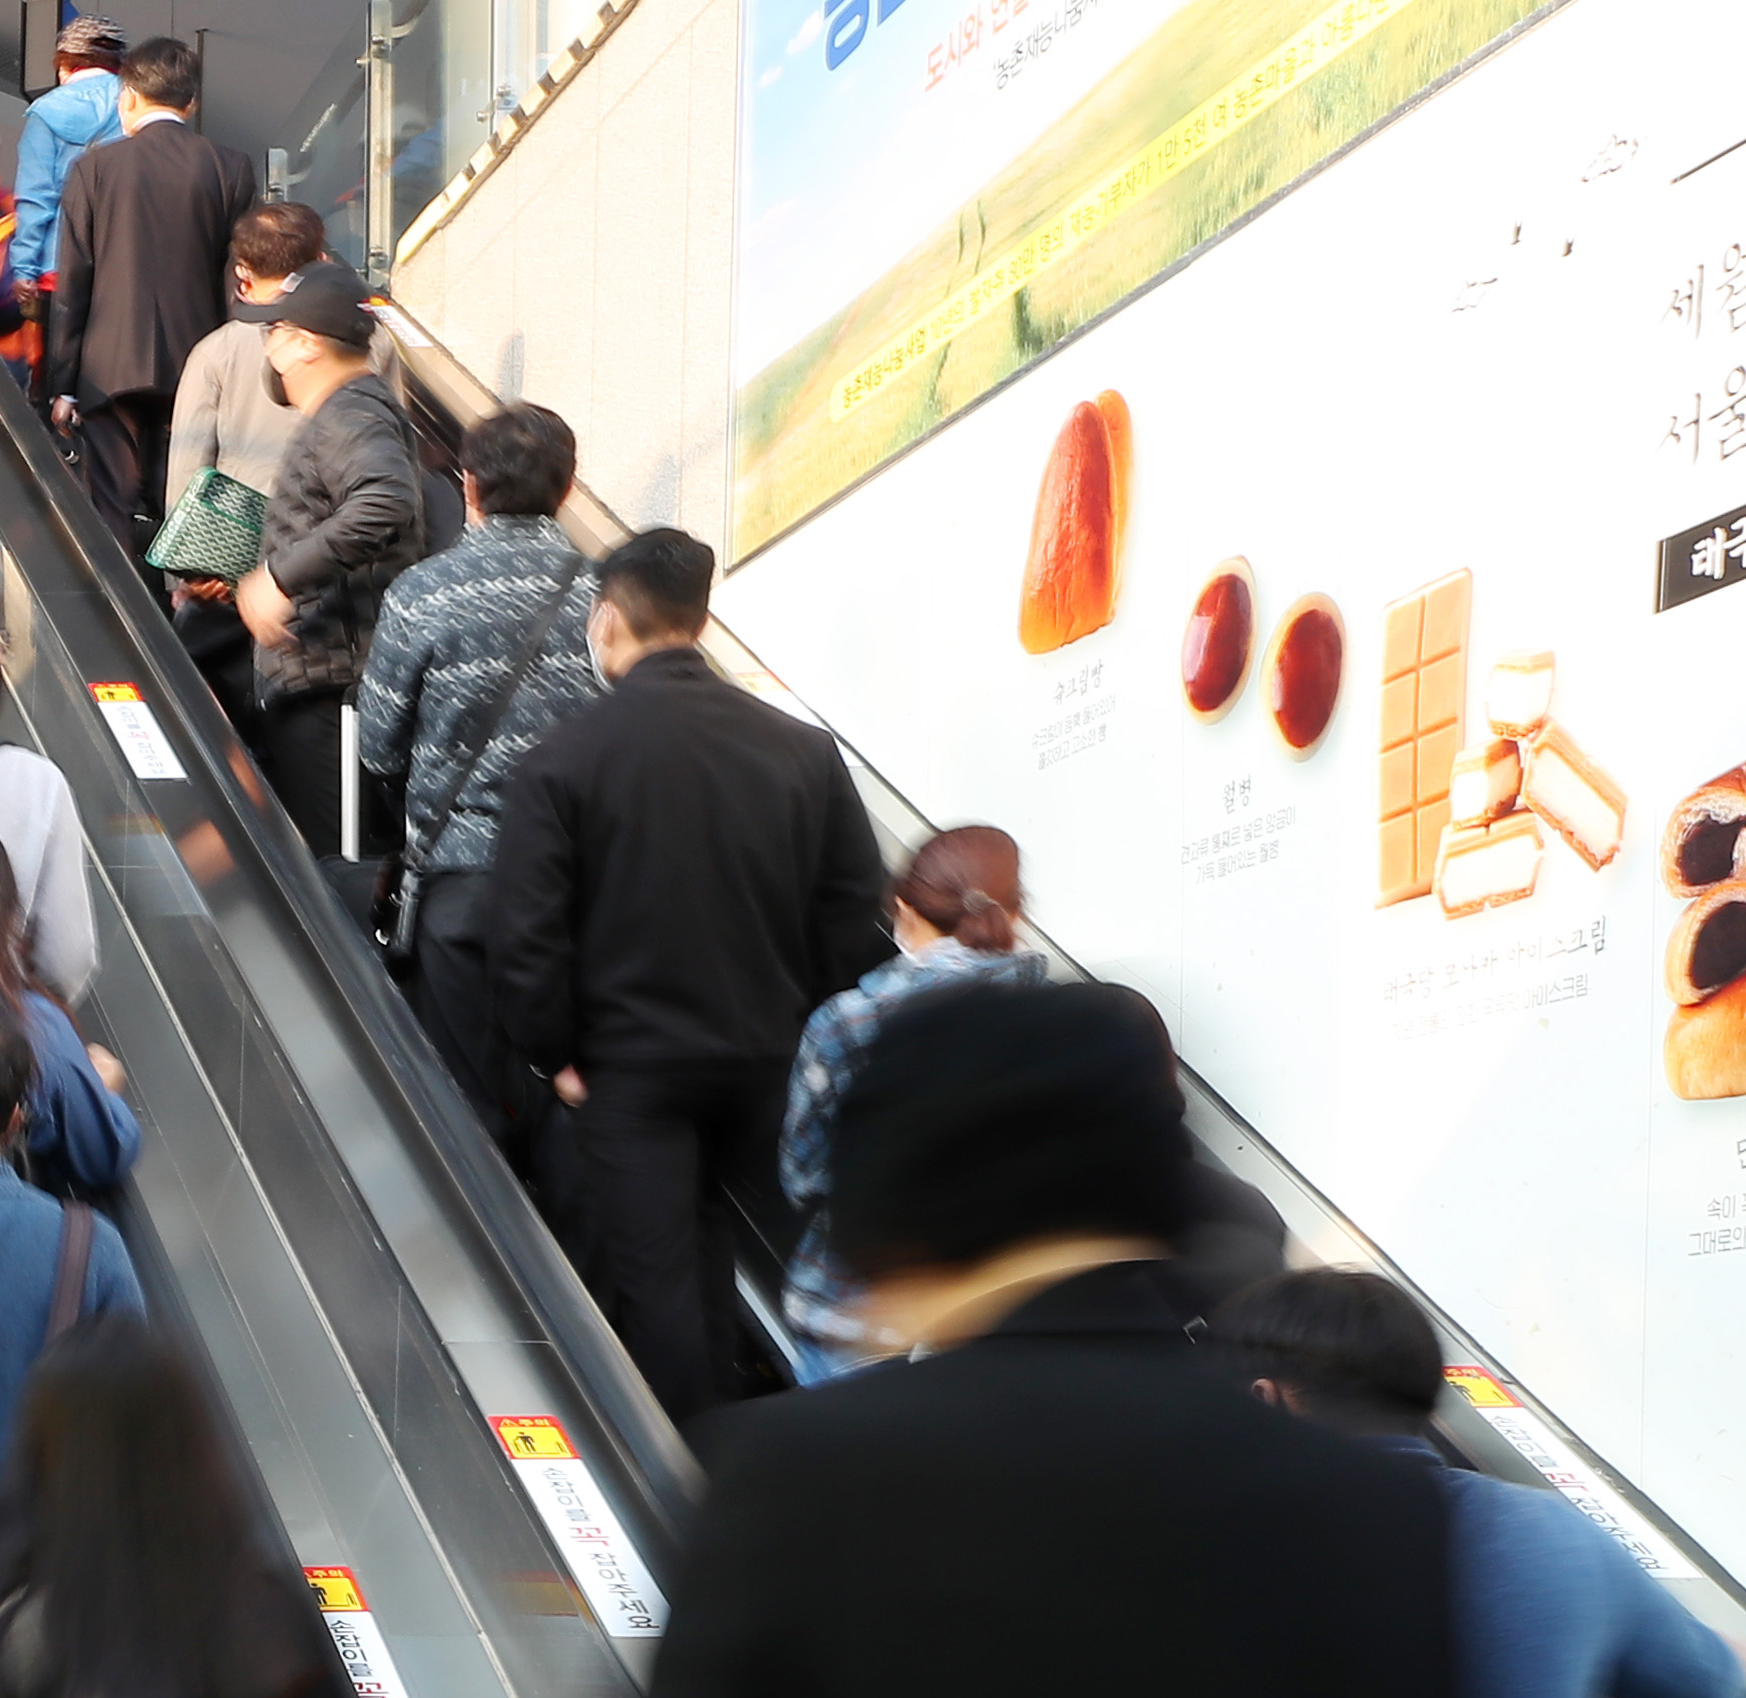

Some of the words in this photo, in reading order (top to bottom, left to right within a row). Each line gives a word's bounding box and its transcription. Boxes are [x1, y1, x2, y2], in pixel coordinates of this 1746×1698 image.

[924, 12, 982, 92] 도시와
[1222, 774, 1252, 815] 월병
[1507, 915, 1608, 969] 아이스크림
[1523, 973, 1590, 1010] 아이스크림
[1706, 1193, 1737, 1220] 속이
[541, 1465, 592, 1523] 손잡이를
[1490, 1414, 1560, 1469] 손잡이를
[1541, 1471, 1591, 1493] 꼭
[1569, 1496, 1669, 1570] 잡아주세요
[568, 1525, 610, 1548] 꼭
[588, 1552, 661, 1631] 잡아주세요
[328, 1618, 374, 1677] 손잡이를
